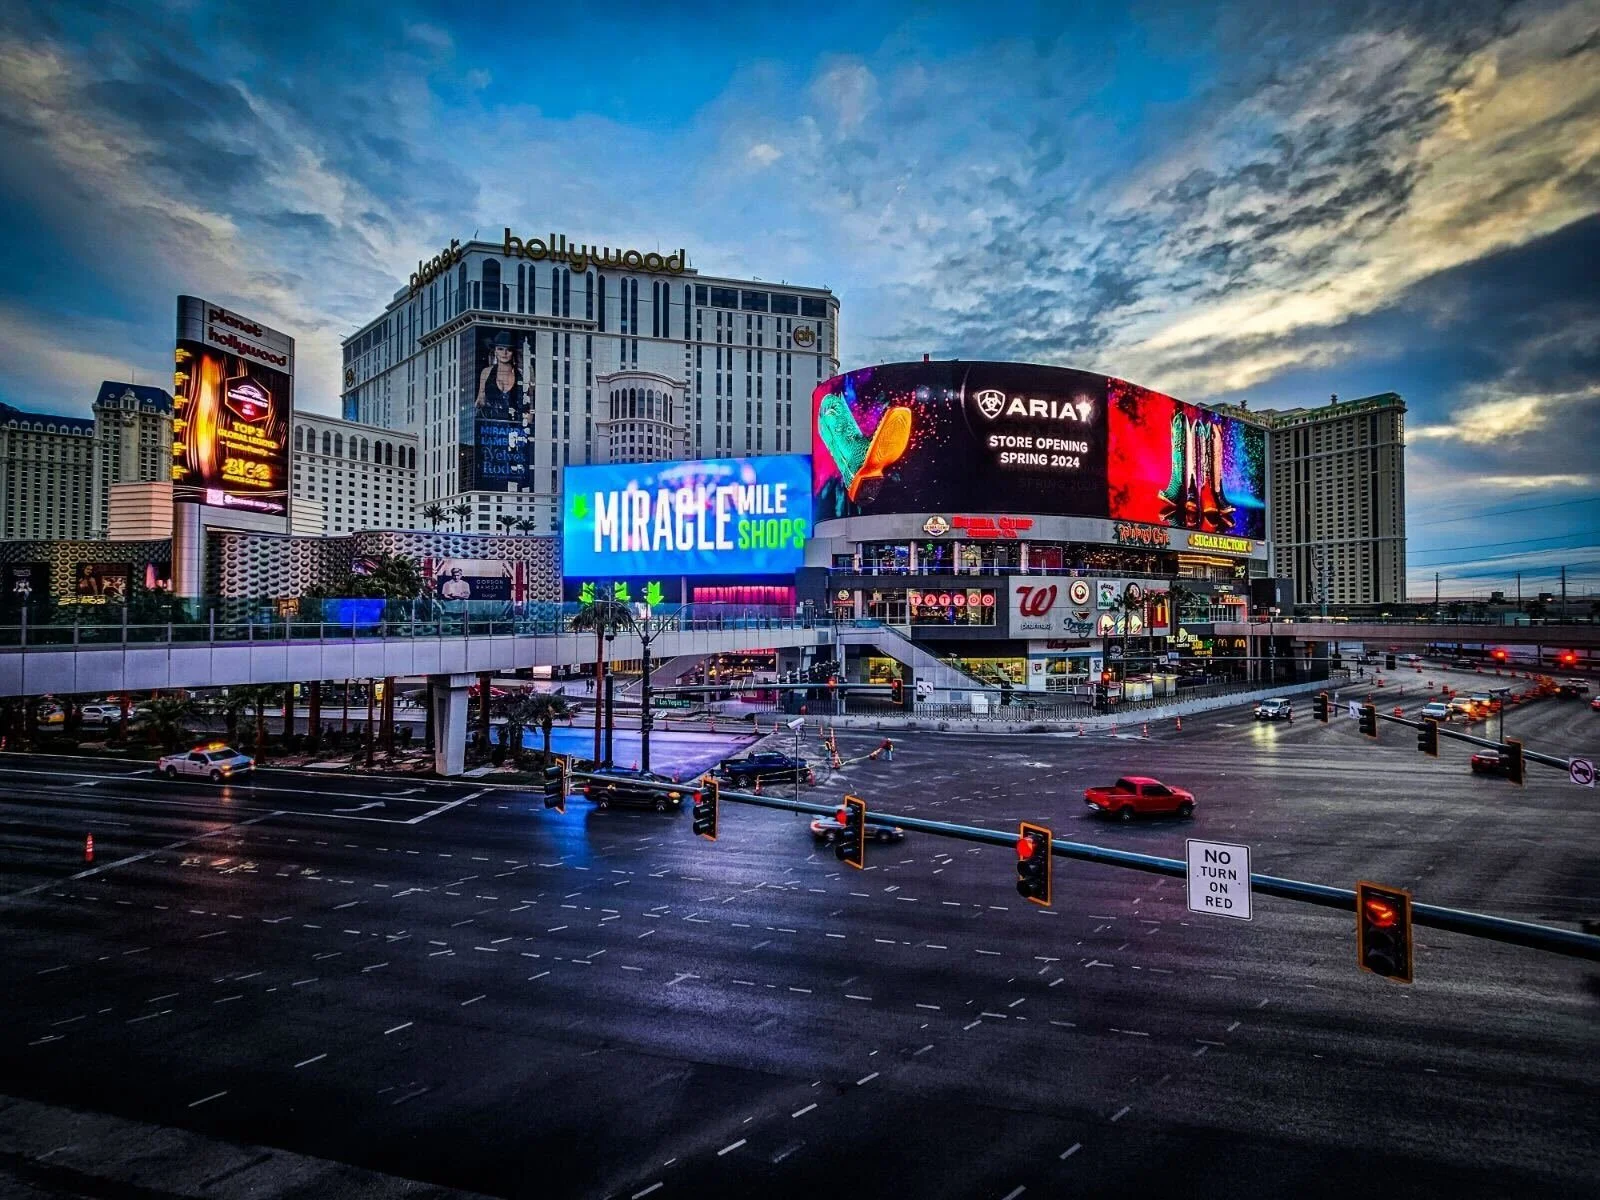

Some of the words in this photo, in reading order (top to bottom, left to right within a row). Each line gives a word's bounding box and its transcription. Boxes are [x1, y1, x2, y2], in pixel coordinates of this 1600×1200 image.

[409, 238, 464, 296] planet
[504, 227, 685, 273] hollywood
[208, 309, 263, 337] planet
[208, 327, 287, 367] hollywood
[1006, 398, 1092, 422] ARIAT
[232, 422, 256, 435] TOP
[989, 435, 1032, 448] STORE
[1036, 438, 1088, 453] OPENING
[1000, 453, 1047, 465] SPRING
[1051, 456, 1080, 468] 2024
[594, 487, 734, 552] MIRACLE
[738, 484, 787, 514] MILE
[738, 518, 806, 549] SHOPS
[1194, 534, 1219, 548] SUGAR
[1219, 536, 1249, 551] FACTORY
[911, 595, 993, 605] TATTOO
[1205, 849, 1231, 864] NO
[1201, 866, 1236, 880] TURN
[1210, 882, 1228, 893] ON
[1205, 896, 1233, 909] RED
